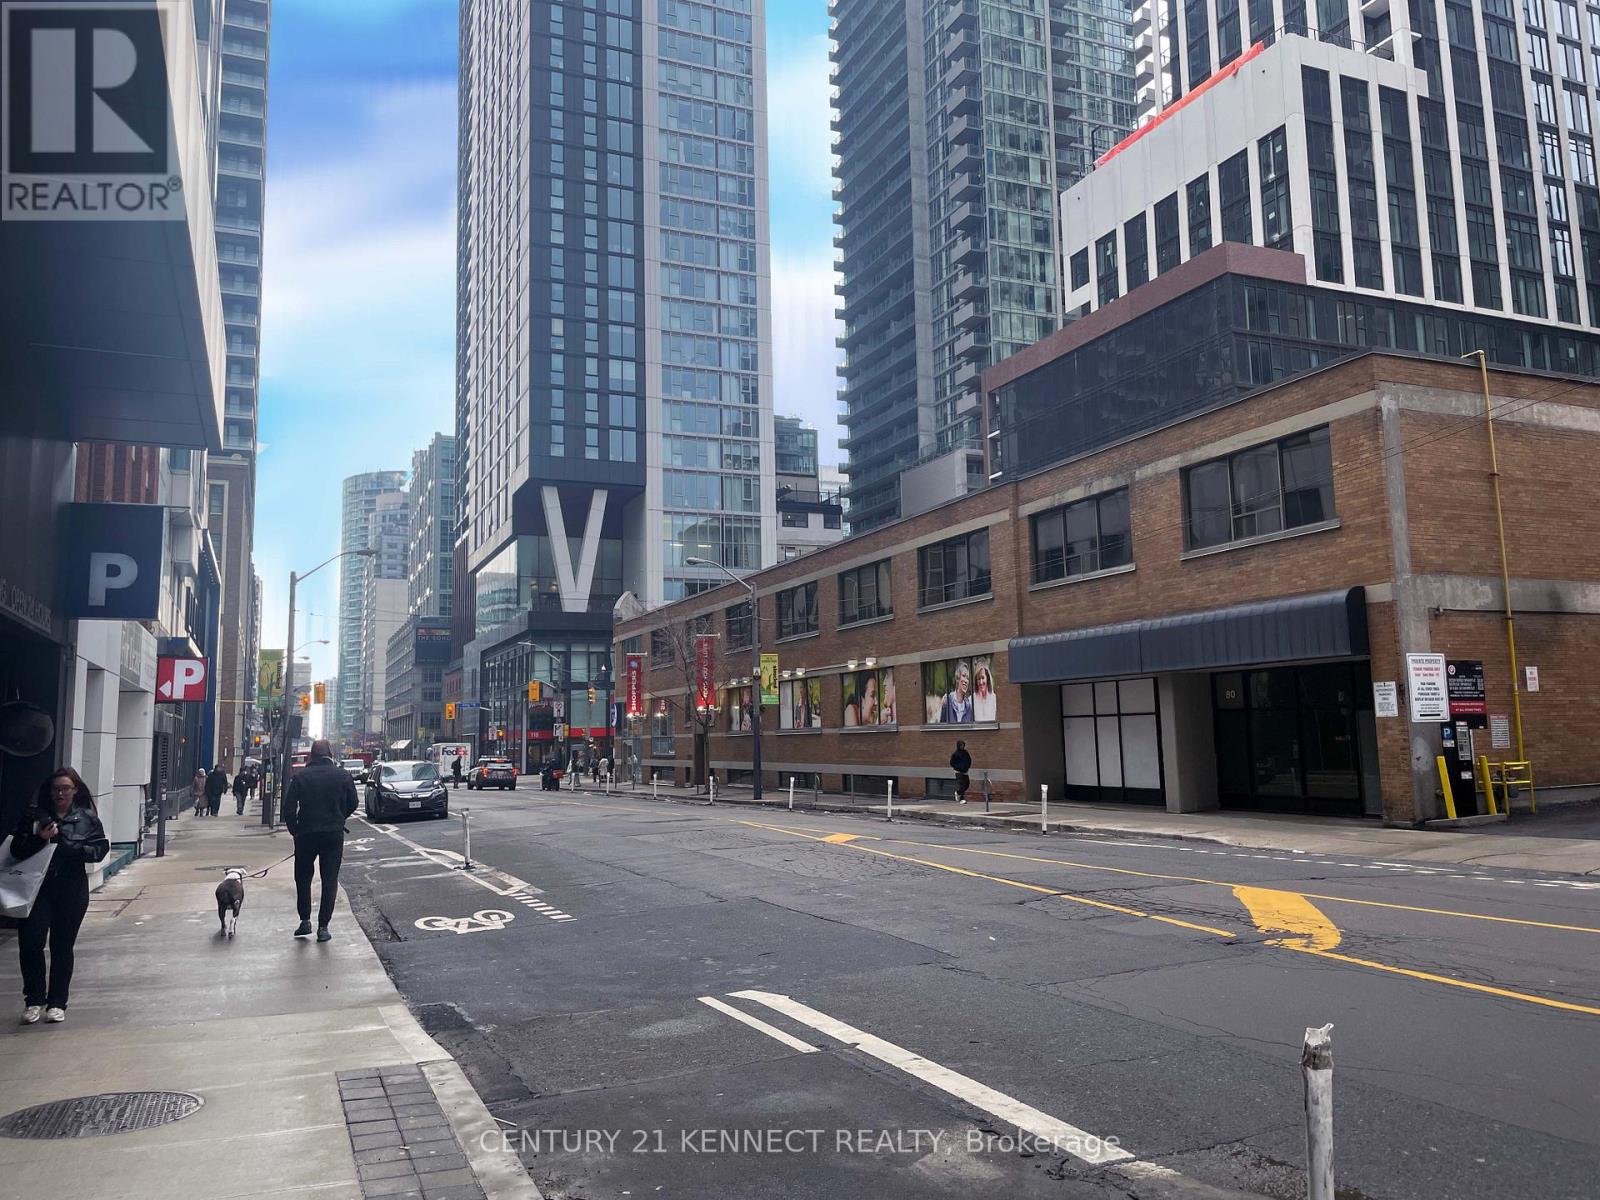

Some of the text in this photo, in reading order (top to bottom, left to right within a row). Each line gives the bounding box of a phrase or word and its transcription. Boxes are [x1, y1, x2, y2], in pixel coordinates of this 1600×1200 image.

[88, 552, 138, 606] P
[173, 659, 205, 699] P
[1443, 728, 1452, 739] P
[441, 747, 470, 755] FedEx
